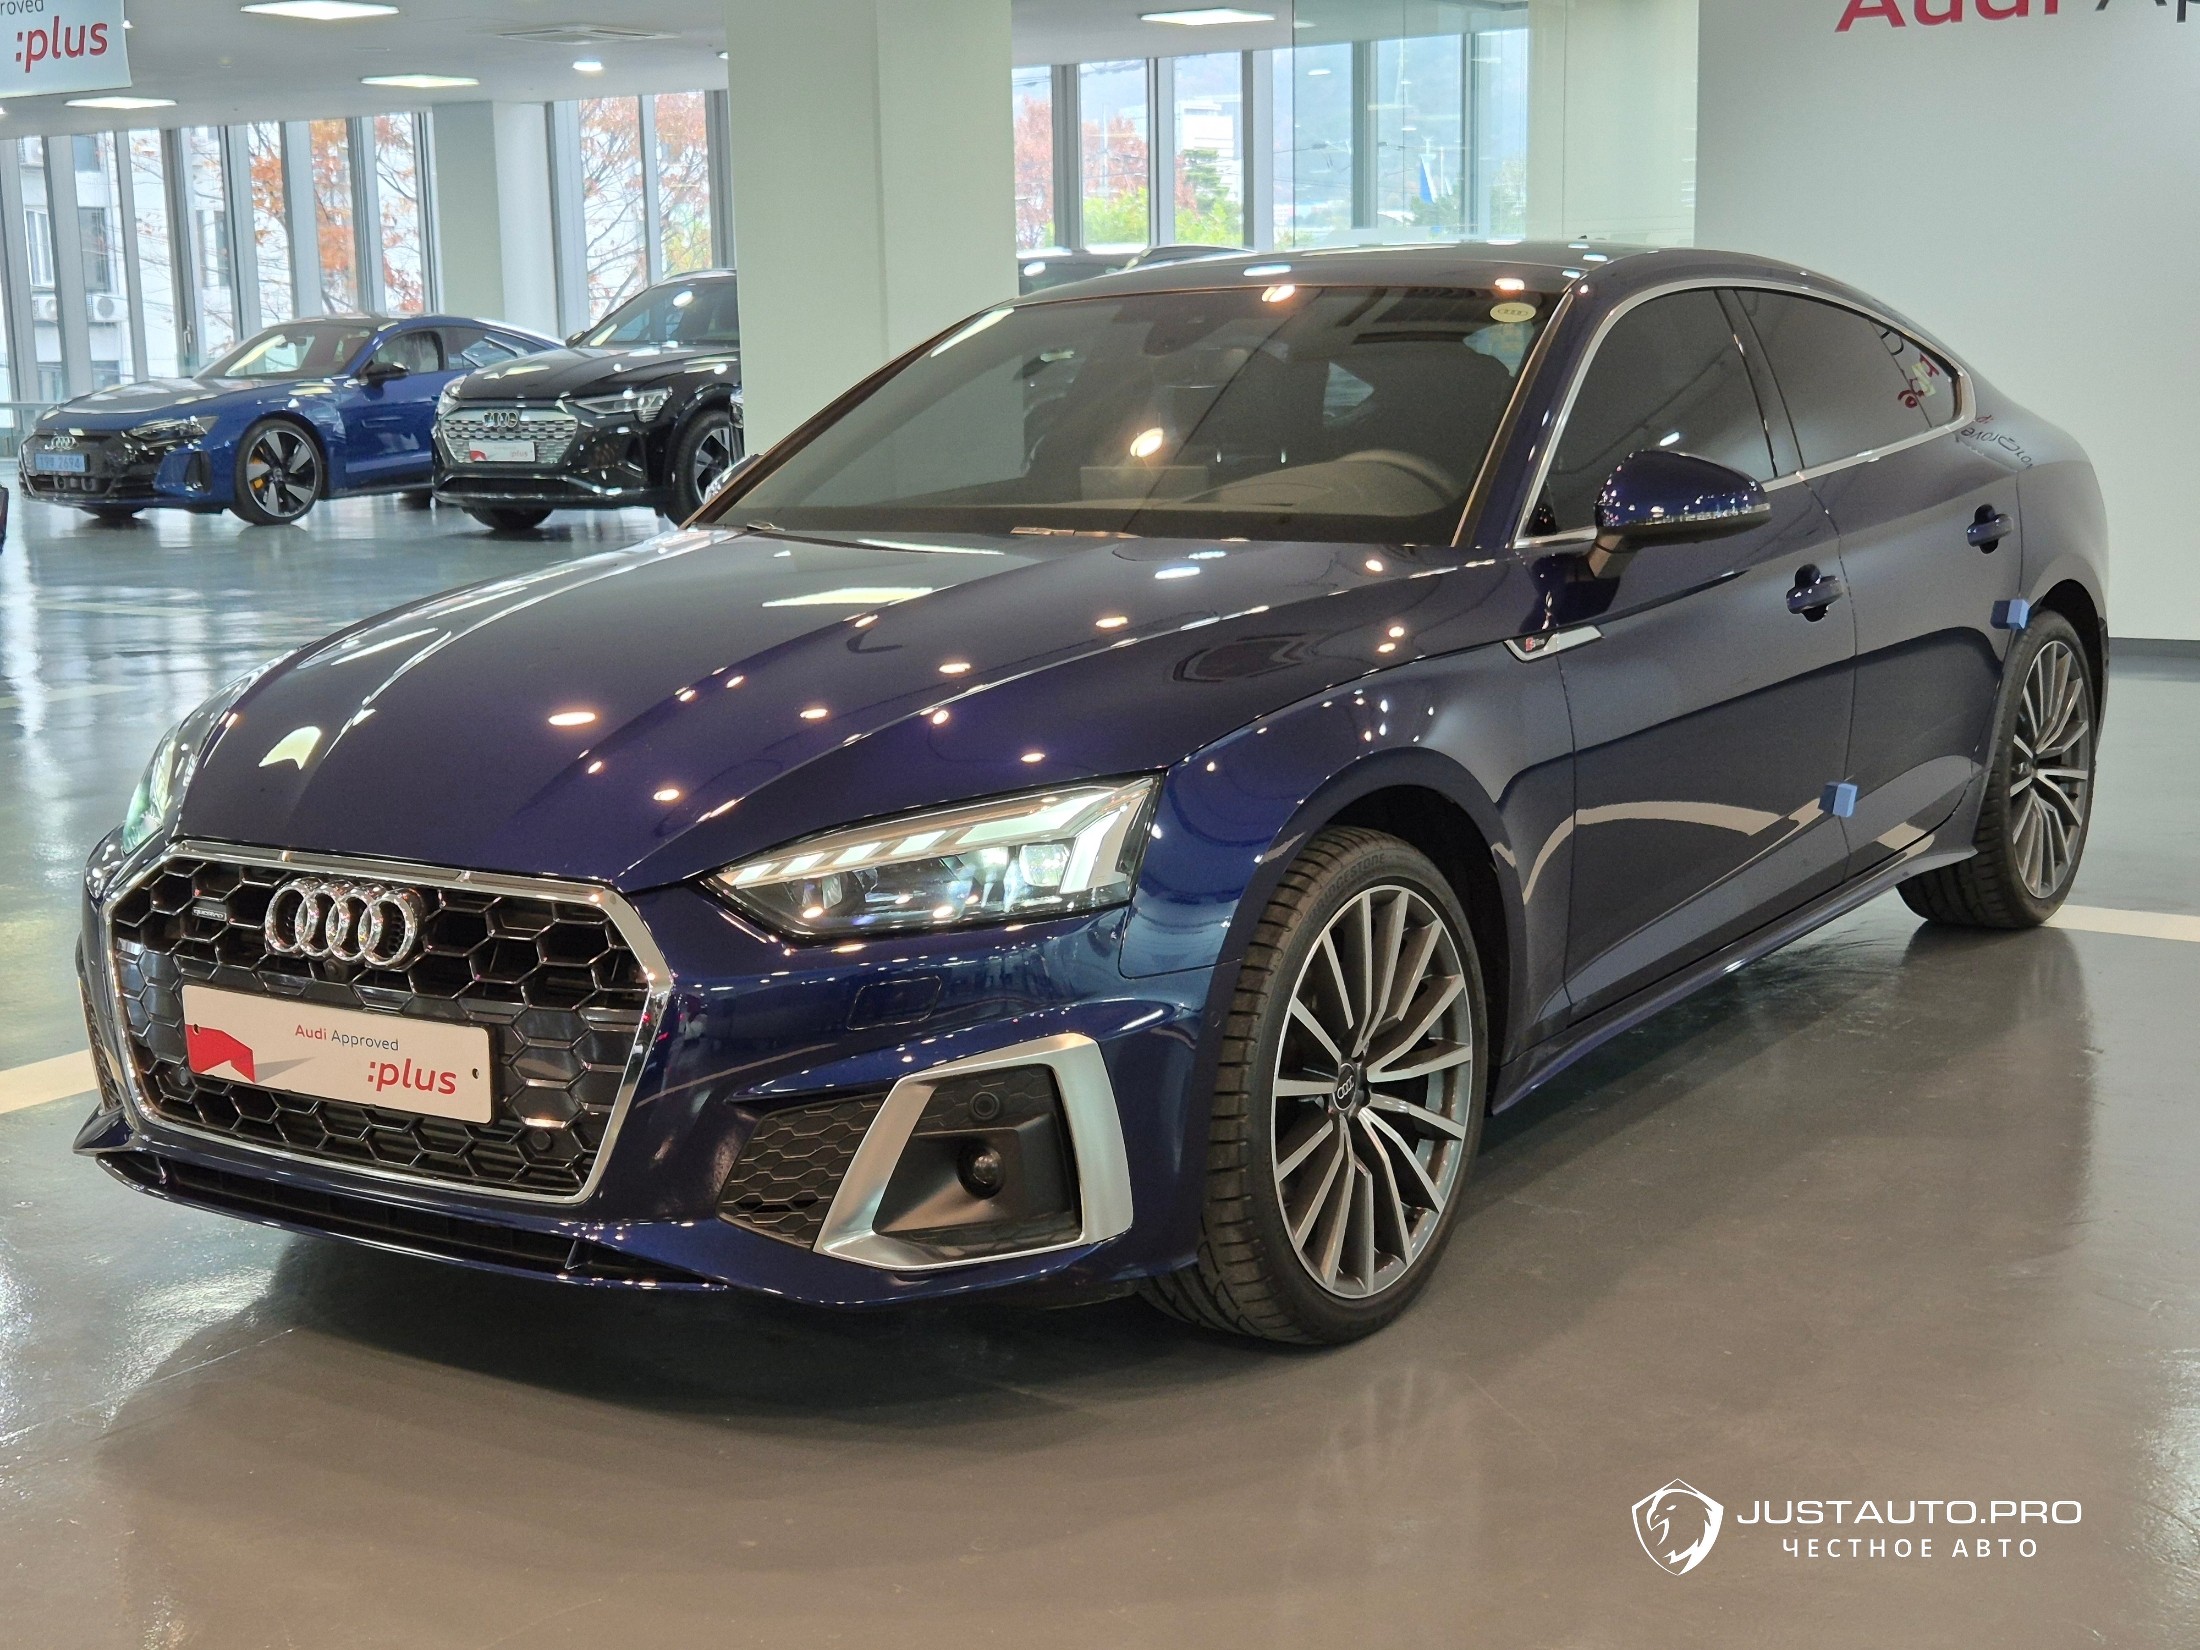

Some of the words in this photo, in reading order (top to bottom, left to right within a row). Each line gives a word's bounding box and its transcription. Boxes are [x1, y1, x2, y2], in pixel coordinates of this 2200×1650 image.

[1835, 0, 2059, 33] Au
[15, 15, 108, 73] :plus
[294, 1024, 327, 1040] Audi
[331, 1029, 399, 1051] Approved
[366, 1057, 457, 1095] :plus
